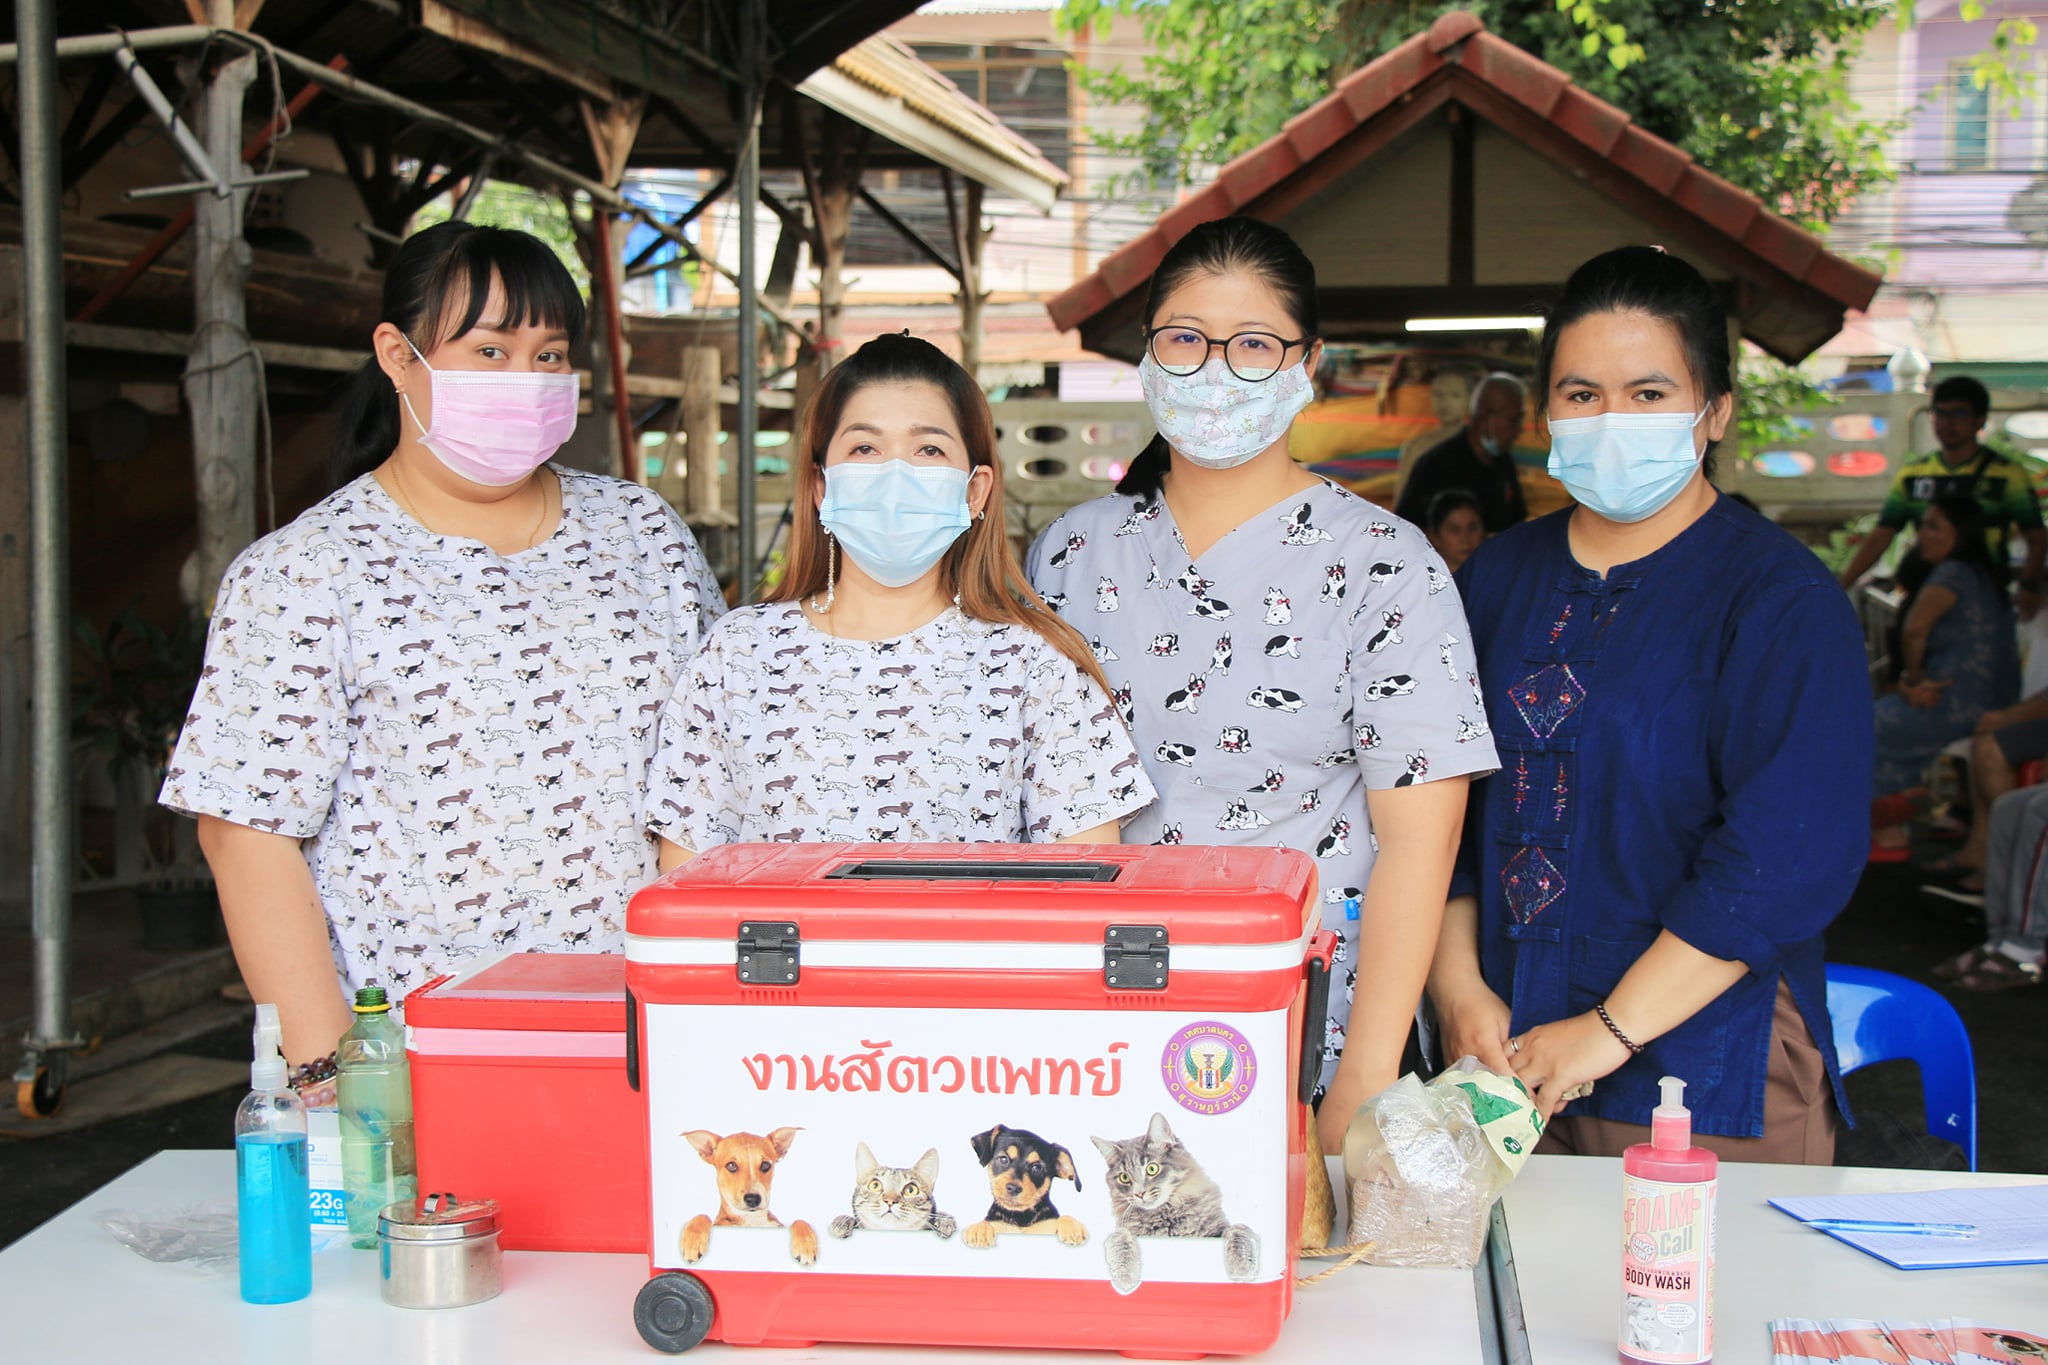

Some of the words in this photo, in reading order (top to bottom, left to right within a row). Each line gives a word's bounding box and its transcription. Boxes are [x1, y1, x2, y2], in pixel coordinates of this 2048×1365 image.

[742, 1039, 1129, 1096] งานสัตวแพทย์
[309, 1191, 344, 1210] 23G
[1624, 1188, 1700, 1235] FOAM
[1660, 1226, 1693, 1257] Call
[1625, 1267, 1652, 1287] BODY
[1654, 1274, 1691, 1290] WASH
